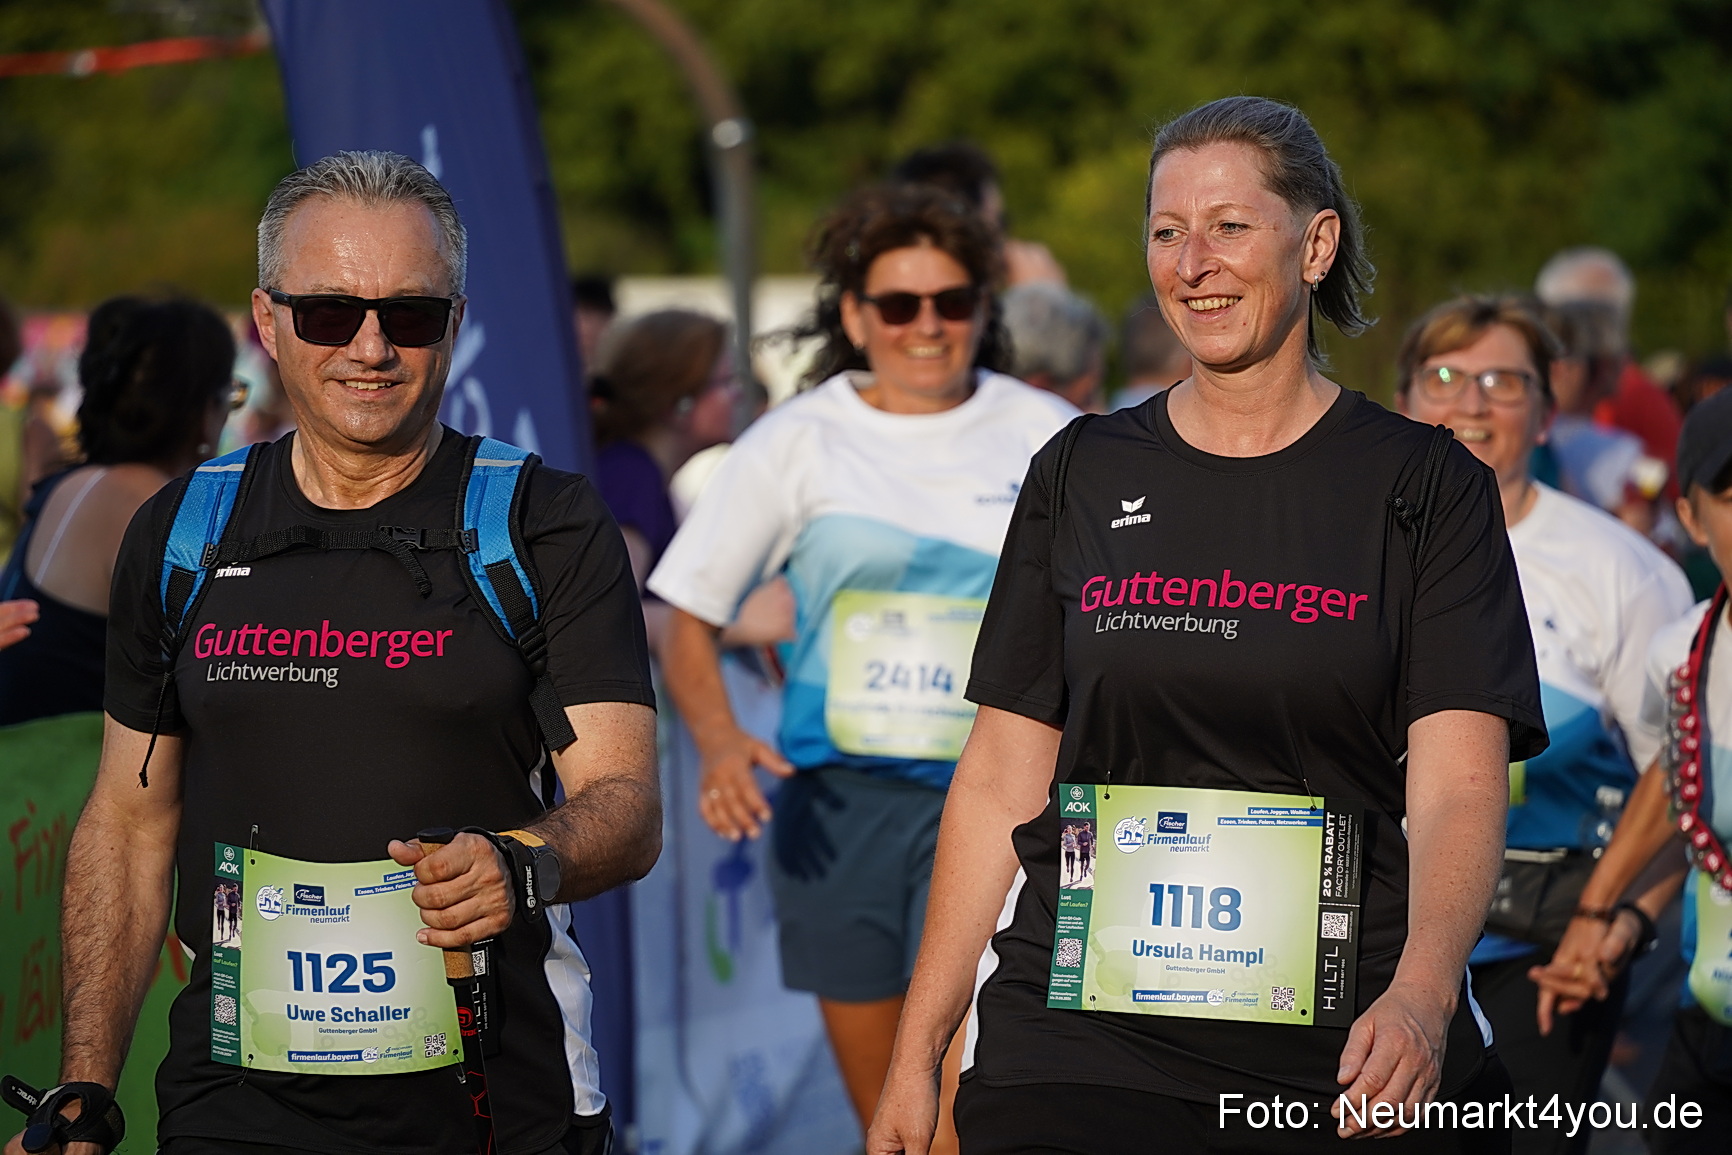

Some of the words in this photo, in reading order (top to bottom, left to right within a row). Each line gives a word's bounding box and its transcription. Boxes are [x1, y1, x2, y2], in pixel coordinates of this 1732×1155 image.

[1110, 512, 1151, 529] erima
[1080, 569, 1368, 624] Guttenberger
[1095, 610, 1240, 640] Lichtwerbung
[194, 619, 453, 669] Guttenberger
[206, 661, 339, 688] Lichtwerbung
[865, 660, 954, 694] 2414
[1064, 801, 1091, 813] AOK
[1160, 816, 1186, 828] Fischer
[1147, 833, 1212, 846] Firmenlauf
[1324, 811, 1336, 864] RABATT
[1337, 814, 1347, 851] OUTLET
[1169, 844, 1210, 853] neumarkt
[218, 861, 240, 875] AOK
[1323, 866, 1333, 876] %
[1335, 852, 1345, 897] FACTORY
[297, 888, 323, 901] Fischer
[1322, 878, 1333, 897] 20
[285, 904, 351, 917] Firmenlauf
[1149, 882, 1242, 931] 1118
[310, 915, 350, 924] neumarkt
[1132, 939, 1194, 961] Ursula
[1198, 943, 1264, 968] Hampl
[286, 950, 396, 994] 1125
[1165, 964, 1206, 974] Guttenberger
[1206, 967, 1226, 975] GmbH
[1322, 945, 1339, 1010] HILTL
[1135, 992, 1204, 1003] firmenlauf.bayern
[1225, 996, 1259, 1004] Firmenlauf
[286, 1003, 326, 1022] Uwe
[330, 1005, 411, 1023] Schaller
[318, 1027, 358, 1035] Guttenberger
[291, 1052, 359, 1063] firmenlauf.bayern
[379, 1049, 413, 1060] Firmenlauf
